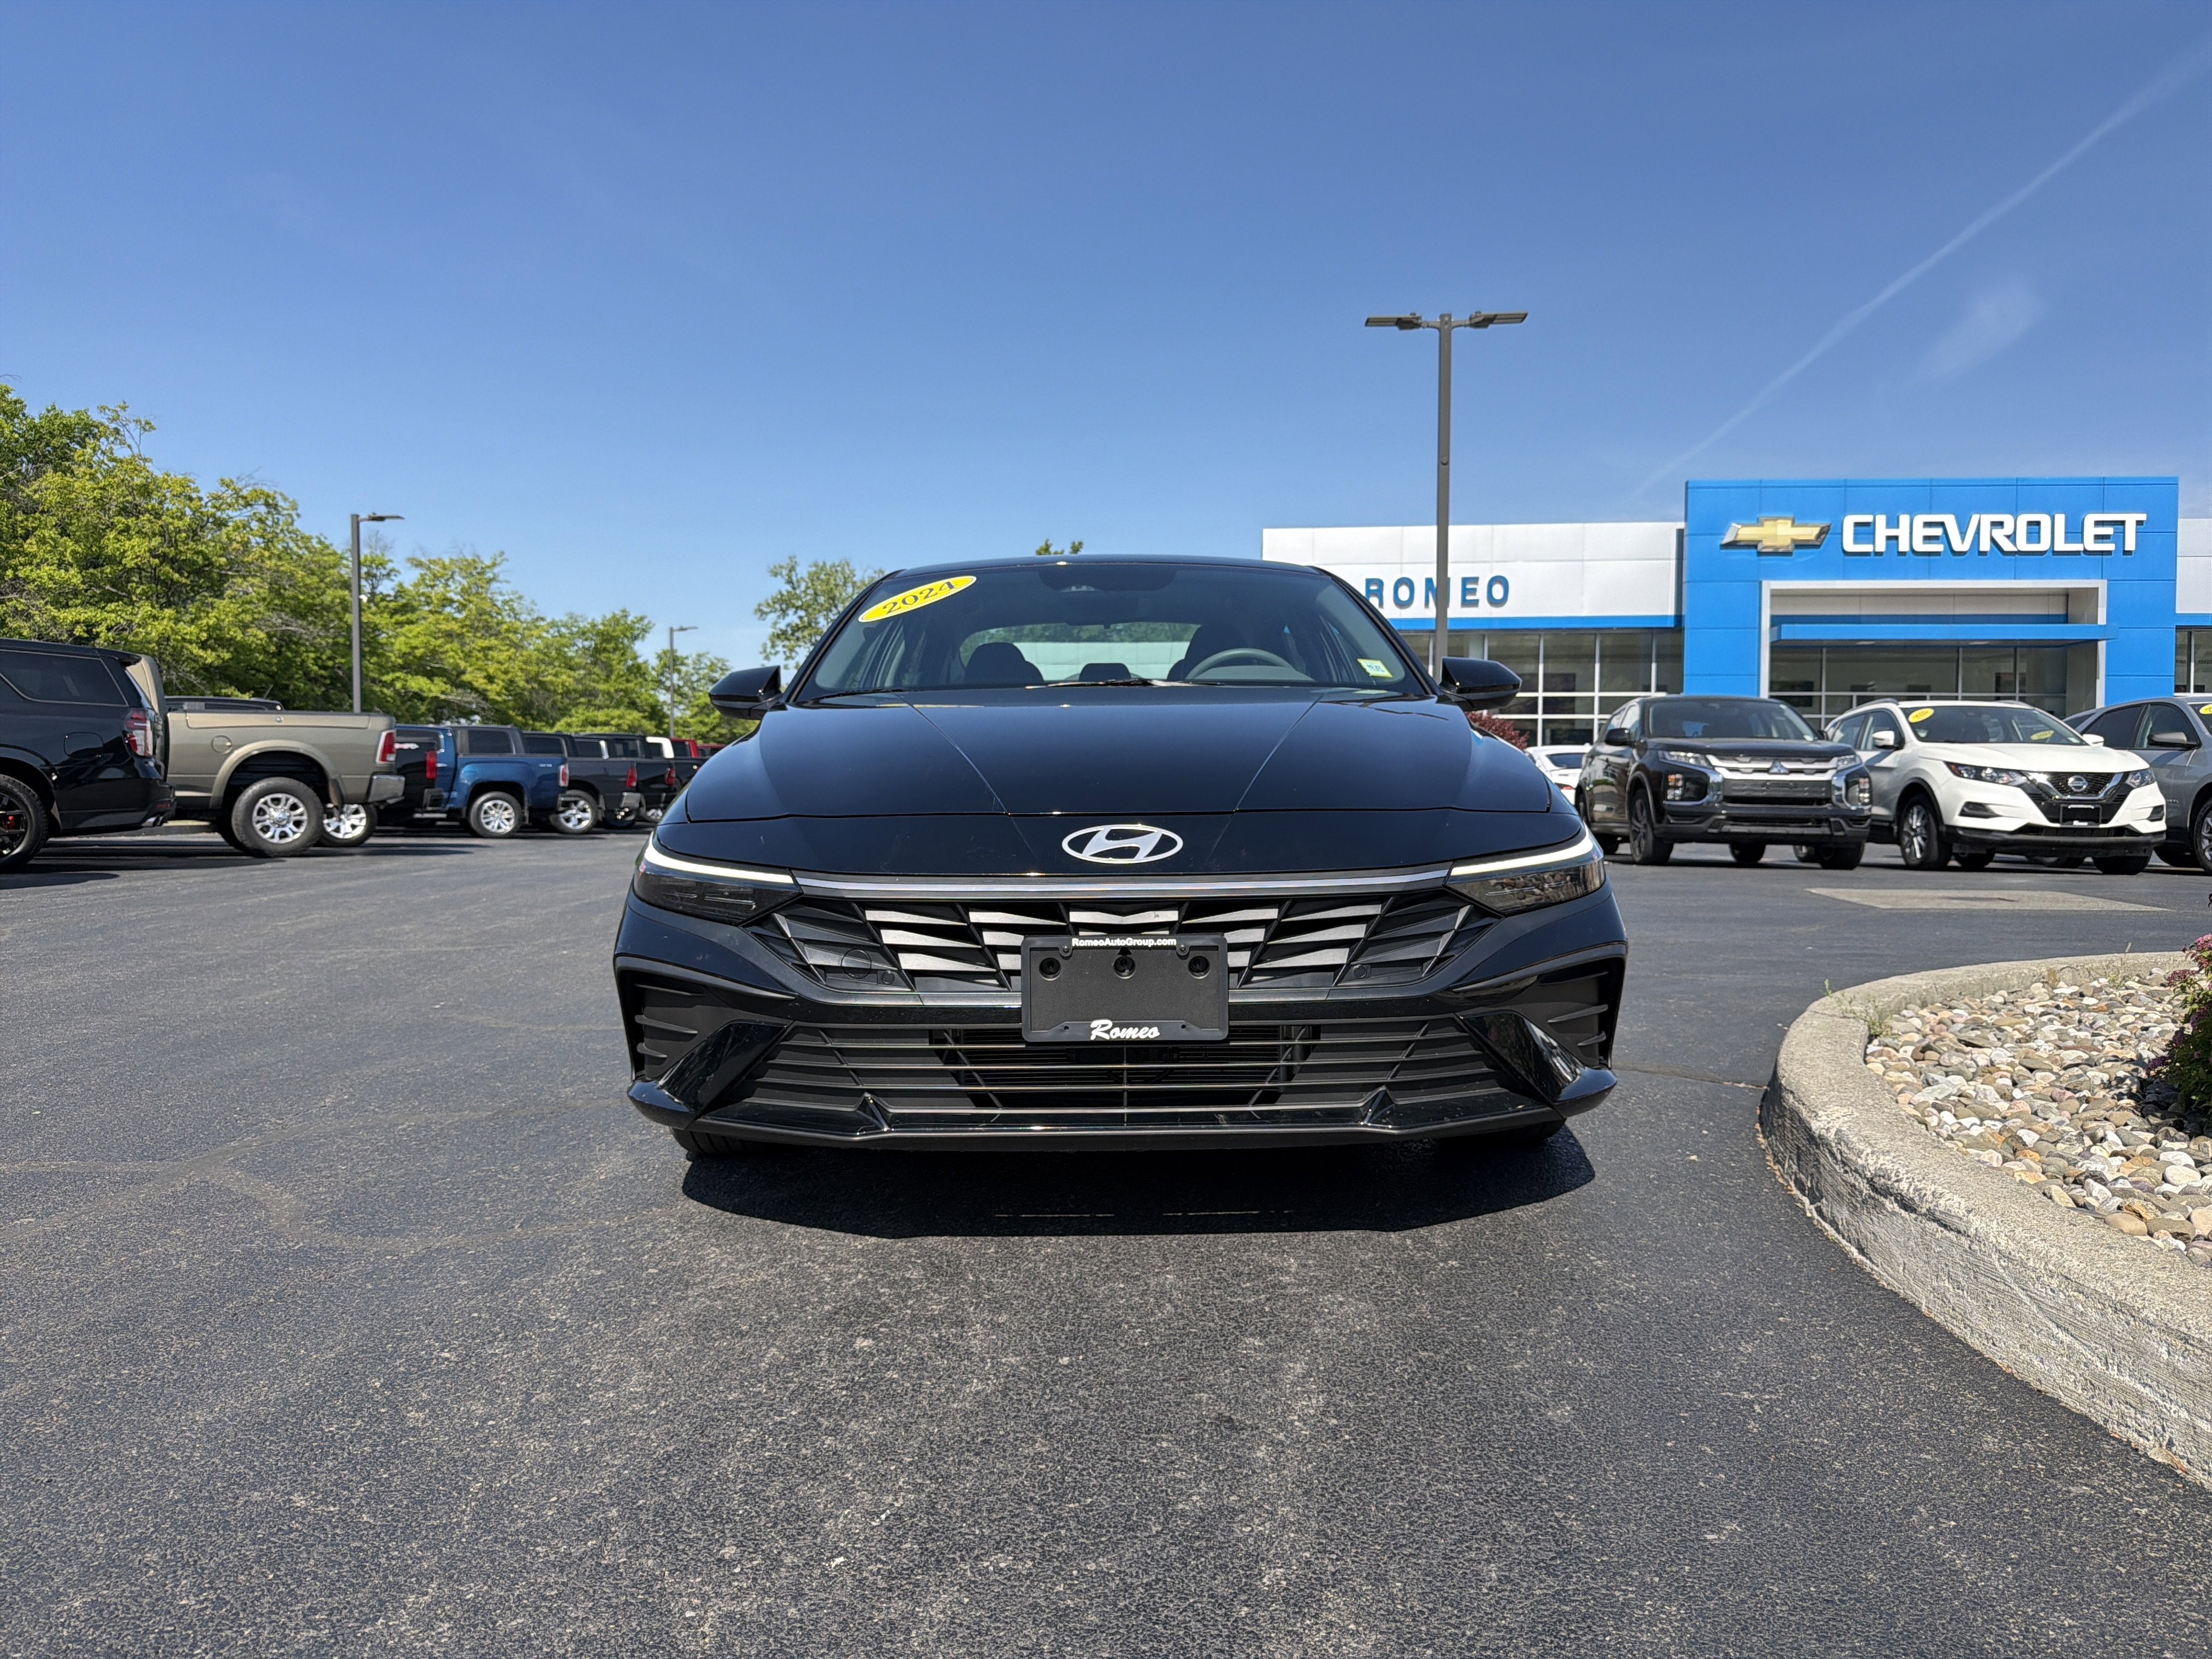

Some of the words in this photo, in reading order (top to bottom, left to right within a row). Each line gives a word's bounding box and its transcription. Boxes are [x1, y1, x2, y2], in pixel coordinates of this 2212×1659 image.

[1842, 514, 2147, 554] CHEVROLET
[882, 581, 957, 614] 2024
[1071, 938, 1177, 947] RomeoAutoGroup.com
[1090, 1019, 1160, 1041] Romeo
